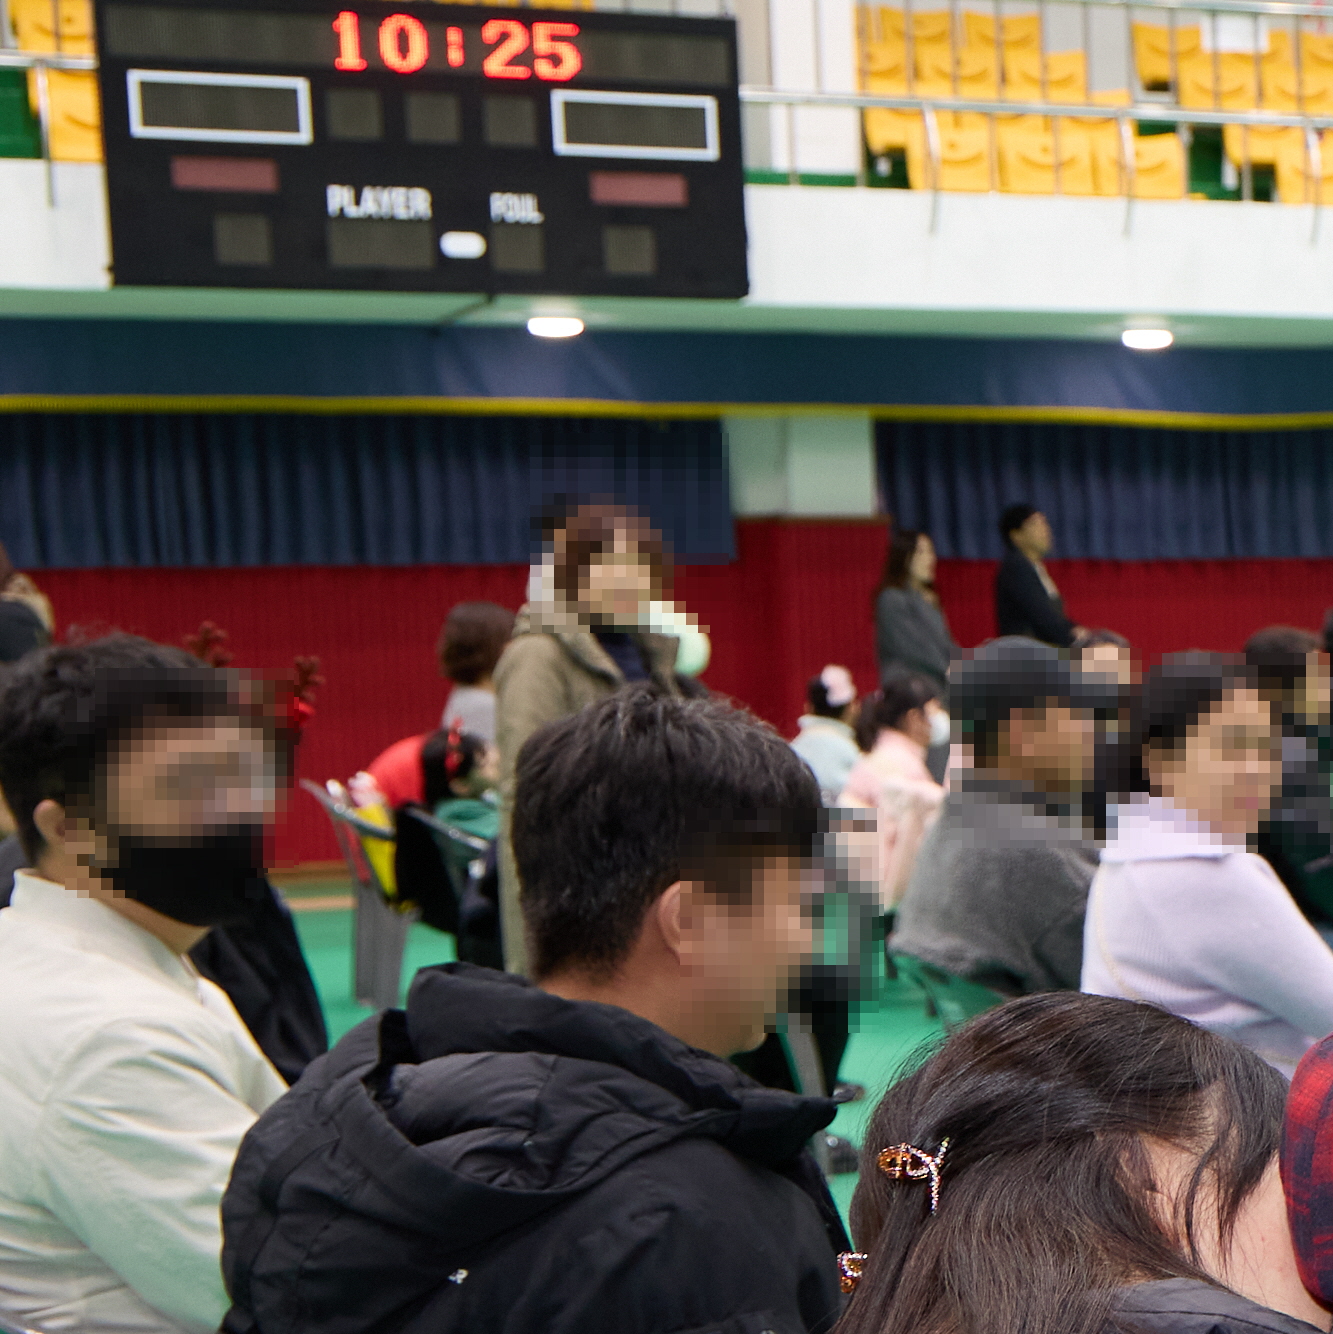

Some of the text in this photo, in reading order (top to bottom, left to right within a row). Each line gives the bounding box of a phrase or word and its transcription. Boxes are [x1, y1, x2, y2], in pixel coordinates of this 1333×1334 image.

[332, 10, 583, 82] 10:25
[326, 183, 434, 221] PLAYER
[489, 191, 545, 224] FOUL
